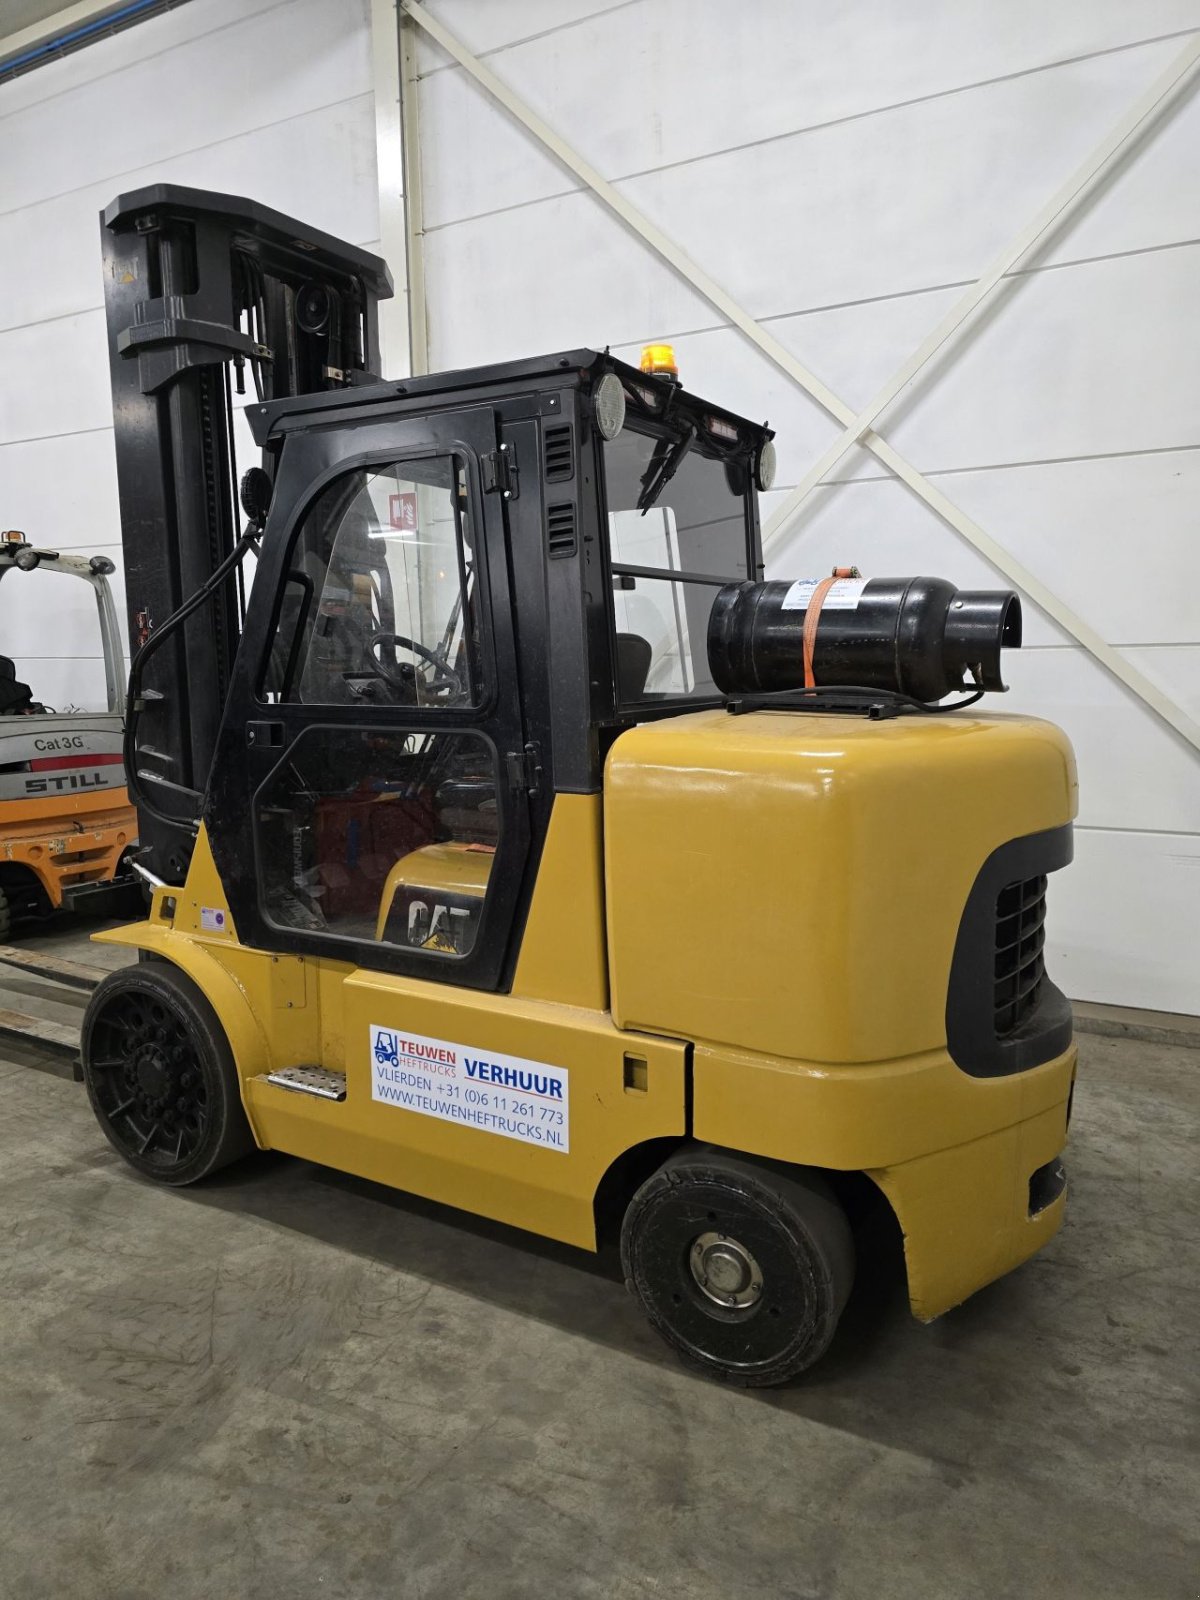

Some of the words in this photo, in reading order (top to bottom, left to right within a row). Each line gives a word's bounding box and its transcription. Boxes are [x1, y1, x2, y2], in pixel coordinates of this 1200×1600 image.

[25, 773, 109, 793] STILL
[400, 1040, 456, 1065] TEUWEN
[400, 1057, 456, 1079] HEFTRUCKS
[464, 1058, 563, 1099] VERHUUR
[377, 1066, 432, 1091] VLIERDEN
[436, 1083, 460, 1098] +31
[464, 1088, 489, 1106] (0)6
[493, 1096, 506, 1110] 11
[511, 1100, 534, 1118] 261
[539, 1107, 563, 1125] 773
[377, 1084, 564, 1146] WWW.TEUWENHEFTRUCKS.NL
